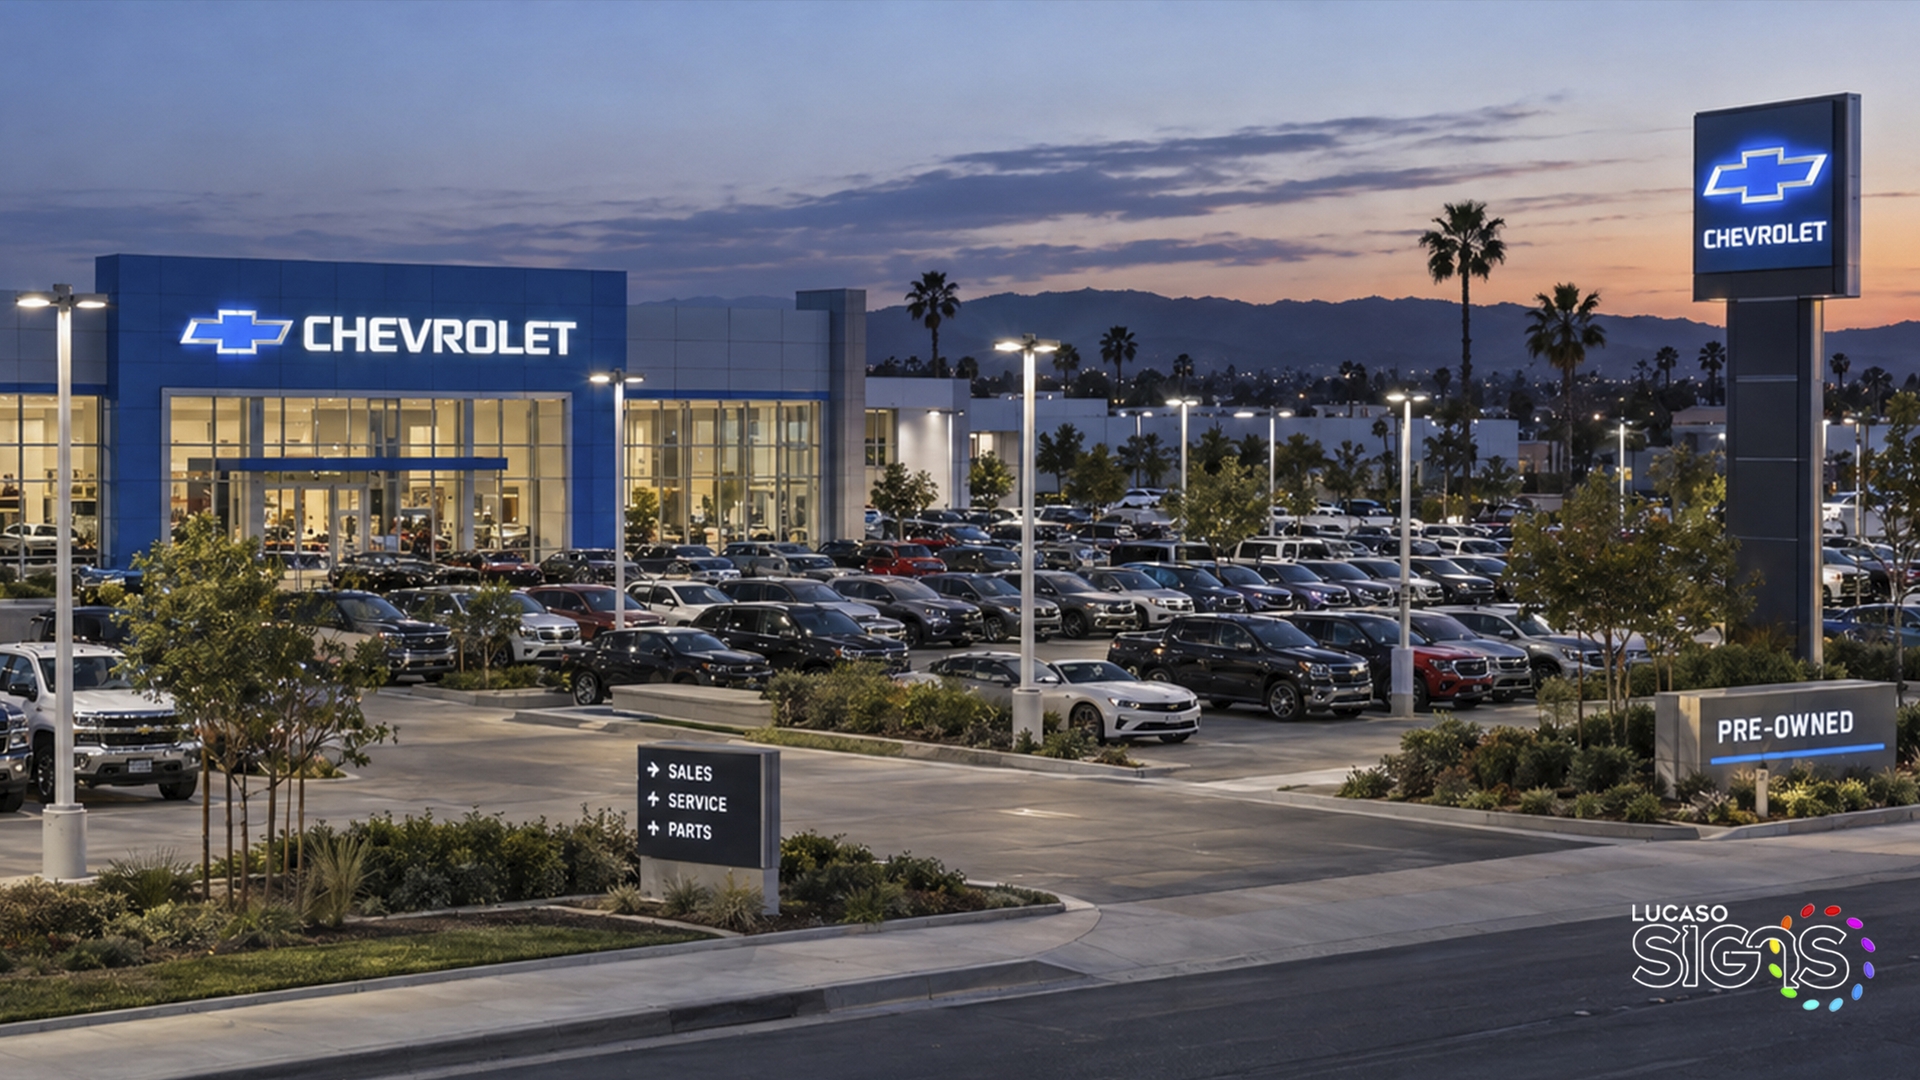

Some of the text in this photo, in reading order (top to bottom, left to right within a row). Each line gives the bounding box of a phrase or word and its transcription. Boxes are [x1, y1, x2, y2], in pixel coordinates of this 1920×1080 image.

[1703, 220, 1828, 250] CHEVROLET
[303, 315, 578, 356] CHEVROLET
[1717, 709, 1854, 744] PRE-OWNED
[668, 763, 713, 782] SALES
[668, 792, 728, 813] SERVICE
[668, 821, 712, 841] PARTS
